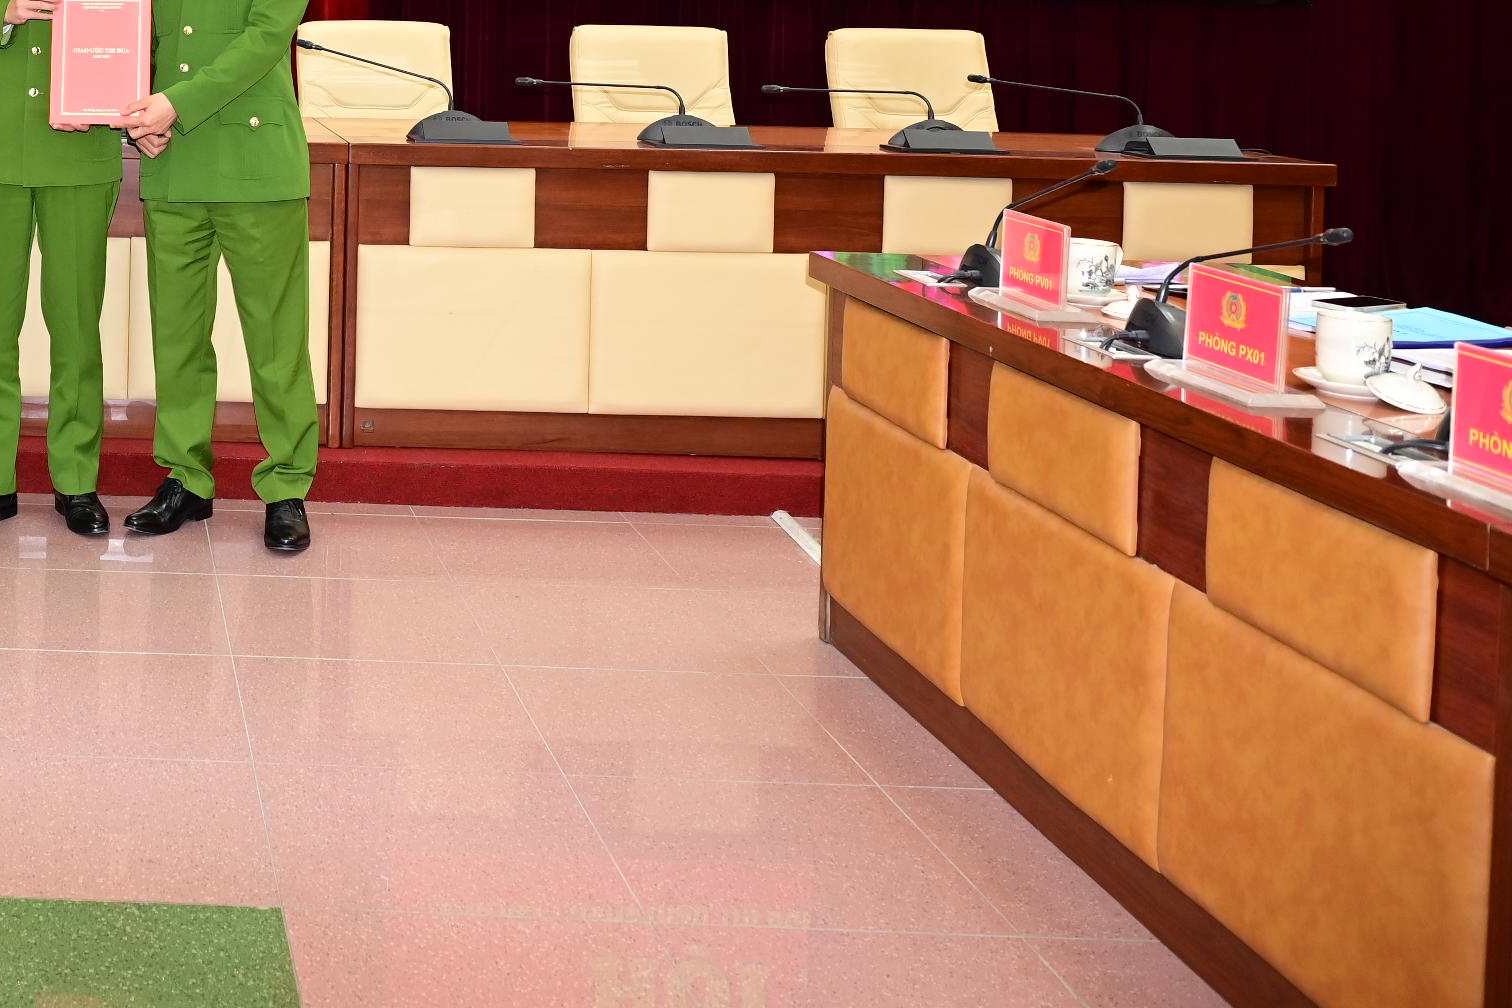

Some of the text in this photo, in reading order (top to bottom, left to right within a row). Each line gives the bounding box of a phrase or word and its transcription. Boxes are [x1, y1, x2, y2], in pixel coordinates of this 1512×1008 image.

[1009, 266, 1053, 291] PHÒNG PV01
[1198, 331, 1266, 367] PHÒNG PX01
[1469, 428, 1512, 459] PHÒN
